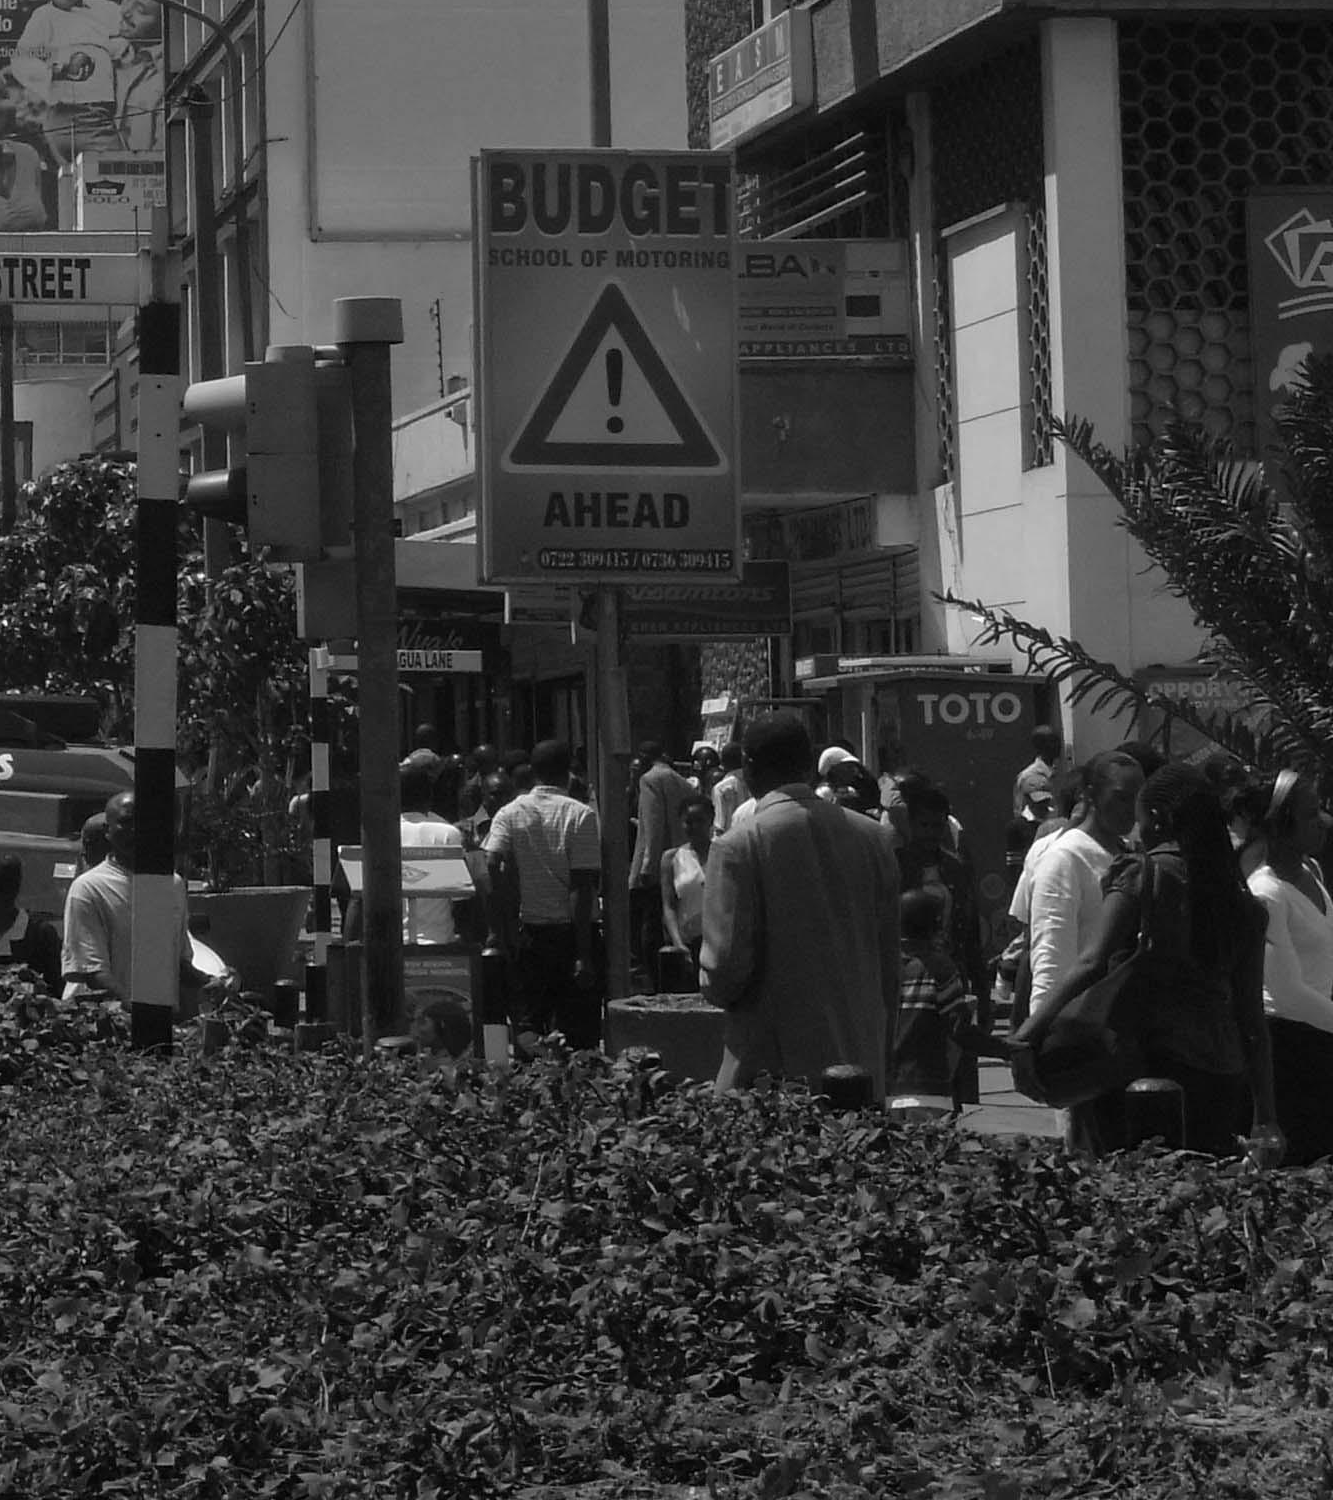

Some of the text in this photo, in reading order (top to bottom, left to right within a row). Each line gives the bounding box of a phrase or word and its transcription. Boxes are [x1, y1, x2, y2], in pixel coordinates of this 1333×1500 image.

[490, 162, 730, 236] BUDGET
[489, 249, 730, 269] SCHOOL OF MOTORING
[543, 492, 690, 529] AHEAD
[540, 552, 575, 568] 0722
[632, 552, 639, 569] /
[399, 651, 453, 669] GUA LANE
[916, 691, 1022, 725] TOTO
